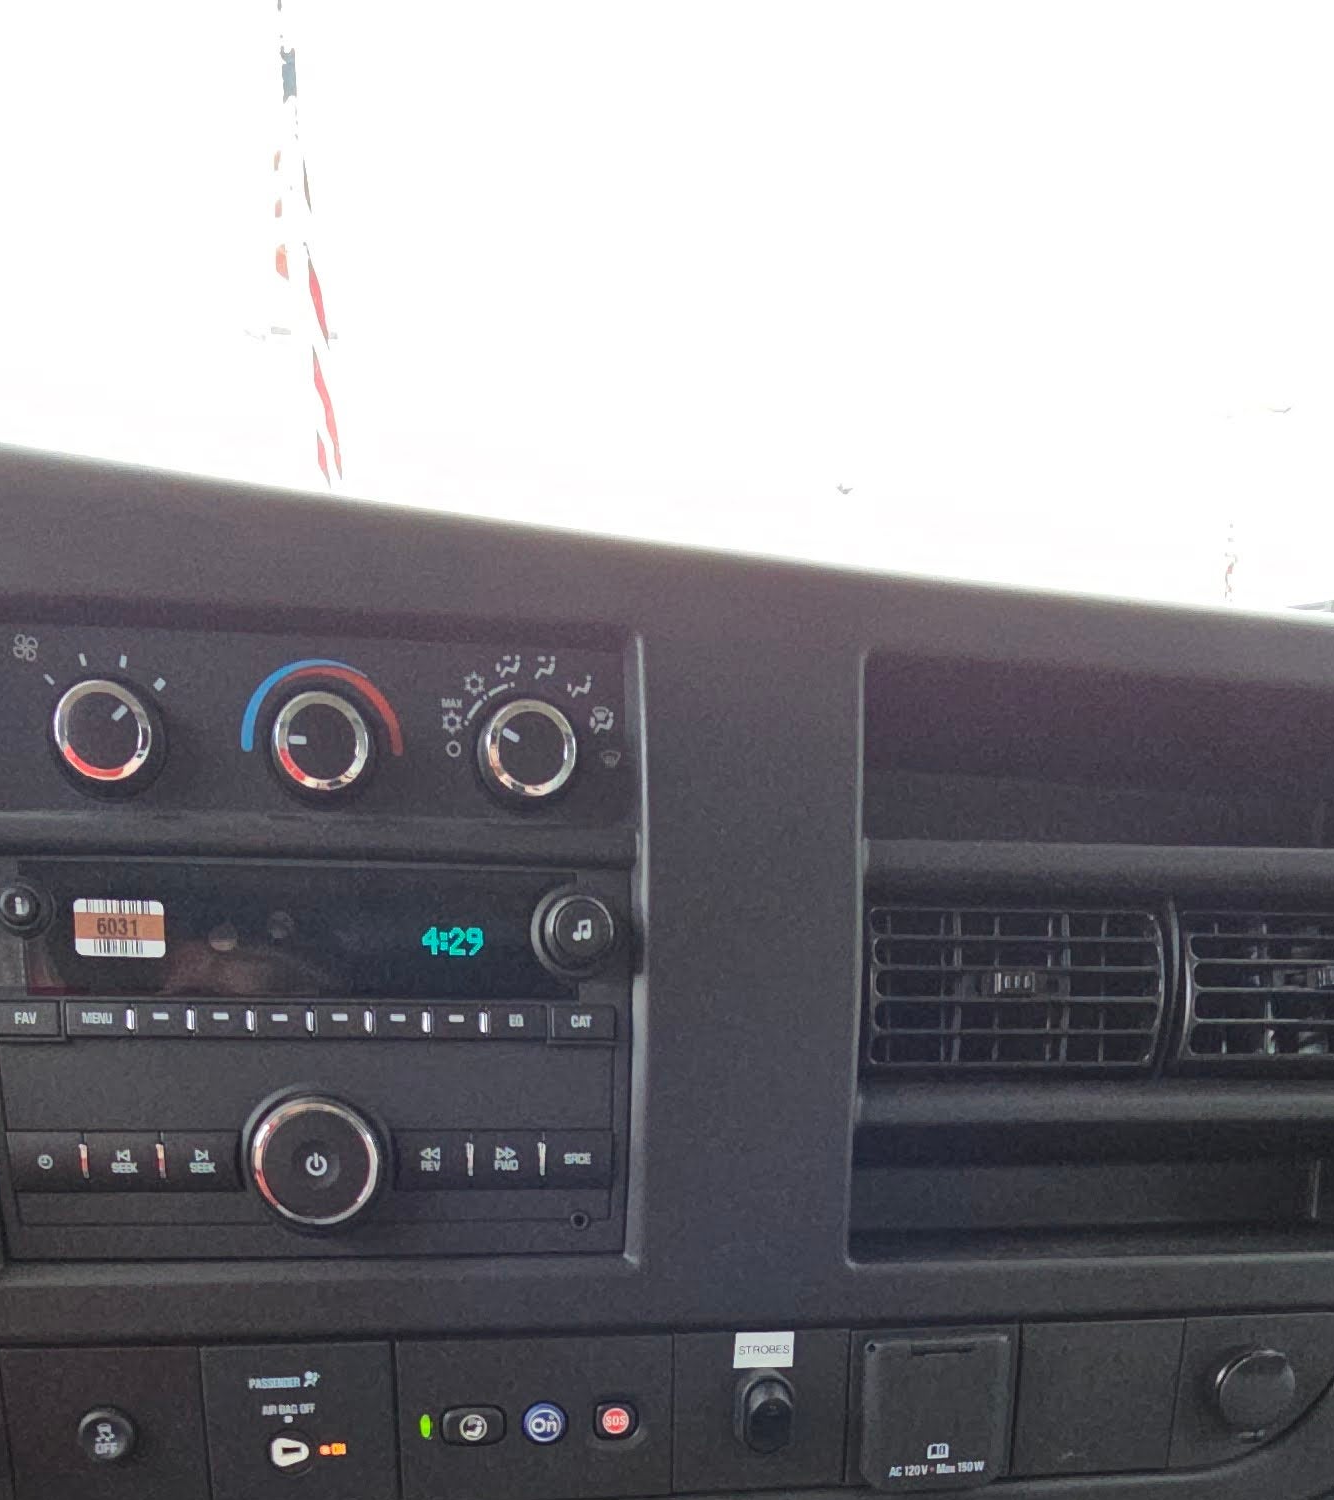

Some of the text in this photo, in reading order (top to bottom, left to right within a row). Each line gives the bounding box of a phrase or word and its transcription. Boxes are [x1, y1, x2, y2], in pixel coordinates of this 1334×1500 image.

[440, 698, 463, 709] MAX
[96, 916, 139, 937] 6031
[421, 926, 484, 956] 4:29
[14, 1011, 37, 1025] FAV
[81, 1012, 113, 1025] MENU
[570, 1015, 592, 1028] CAT
[420, 1159, 441, 1171] REV
[494, 1159, 519, 1171] FWD
[563, 1152, 592, 1165] SRCE
[110, 1161, 138, 1174] SEEK
[189, 1161, 216, 1174] SEEK
[738, 1344, 790, 1355] STROBES
[605, 1415, 627, 1427] SOS
[95, 1442, 118, 1455] OFF
[889, 1466, 903, 1477] AC
